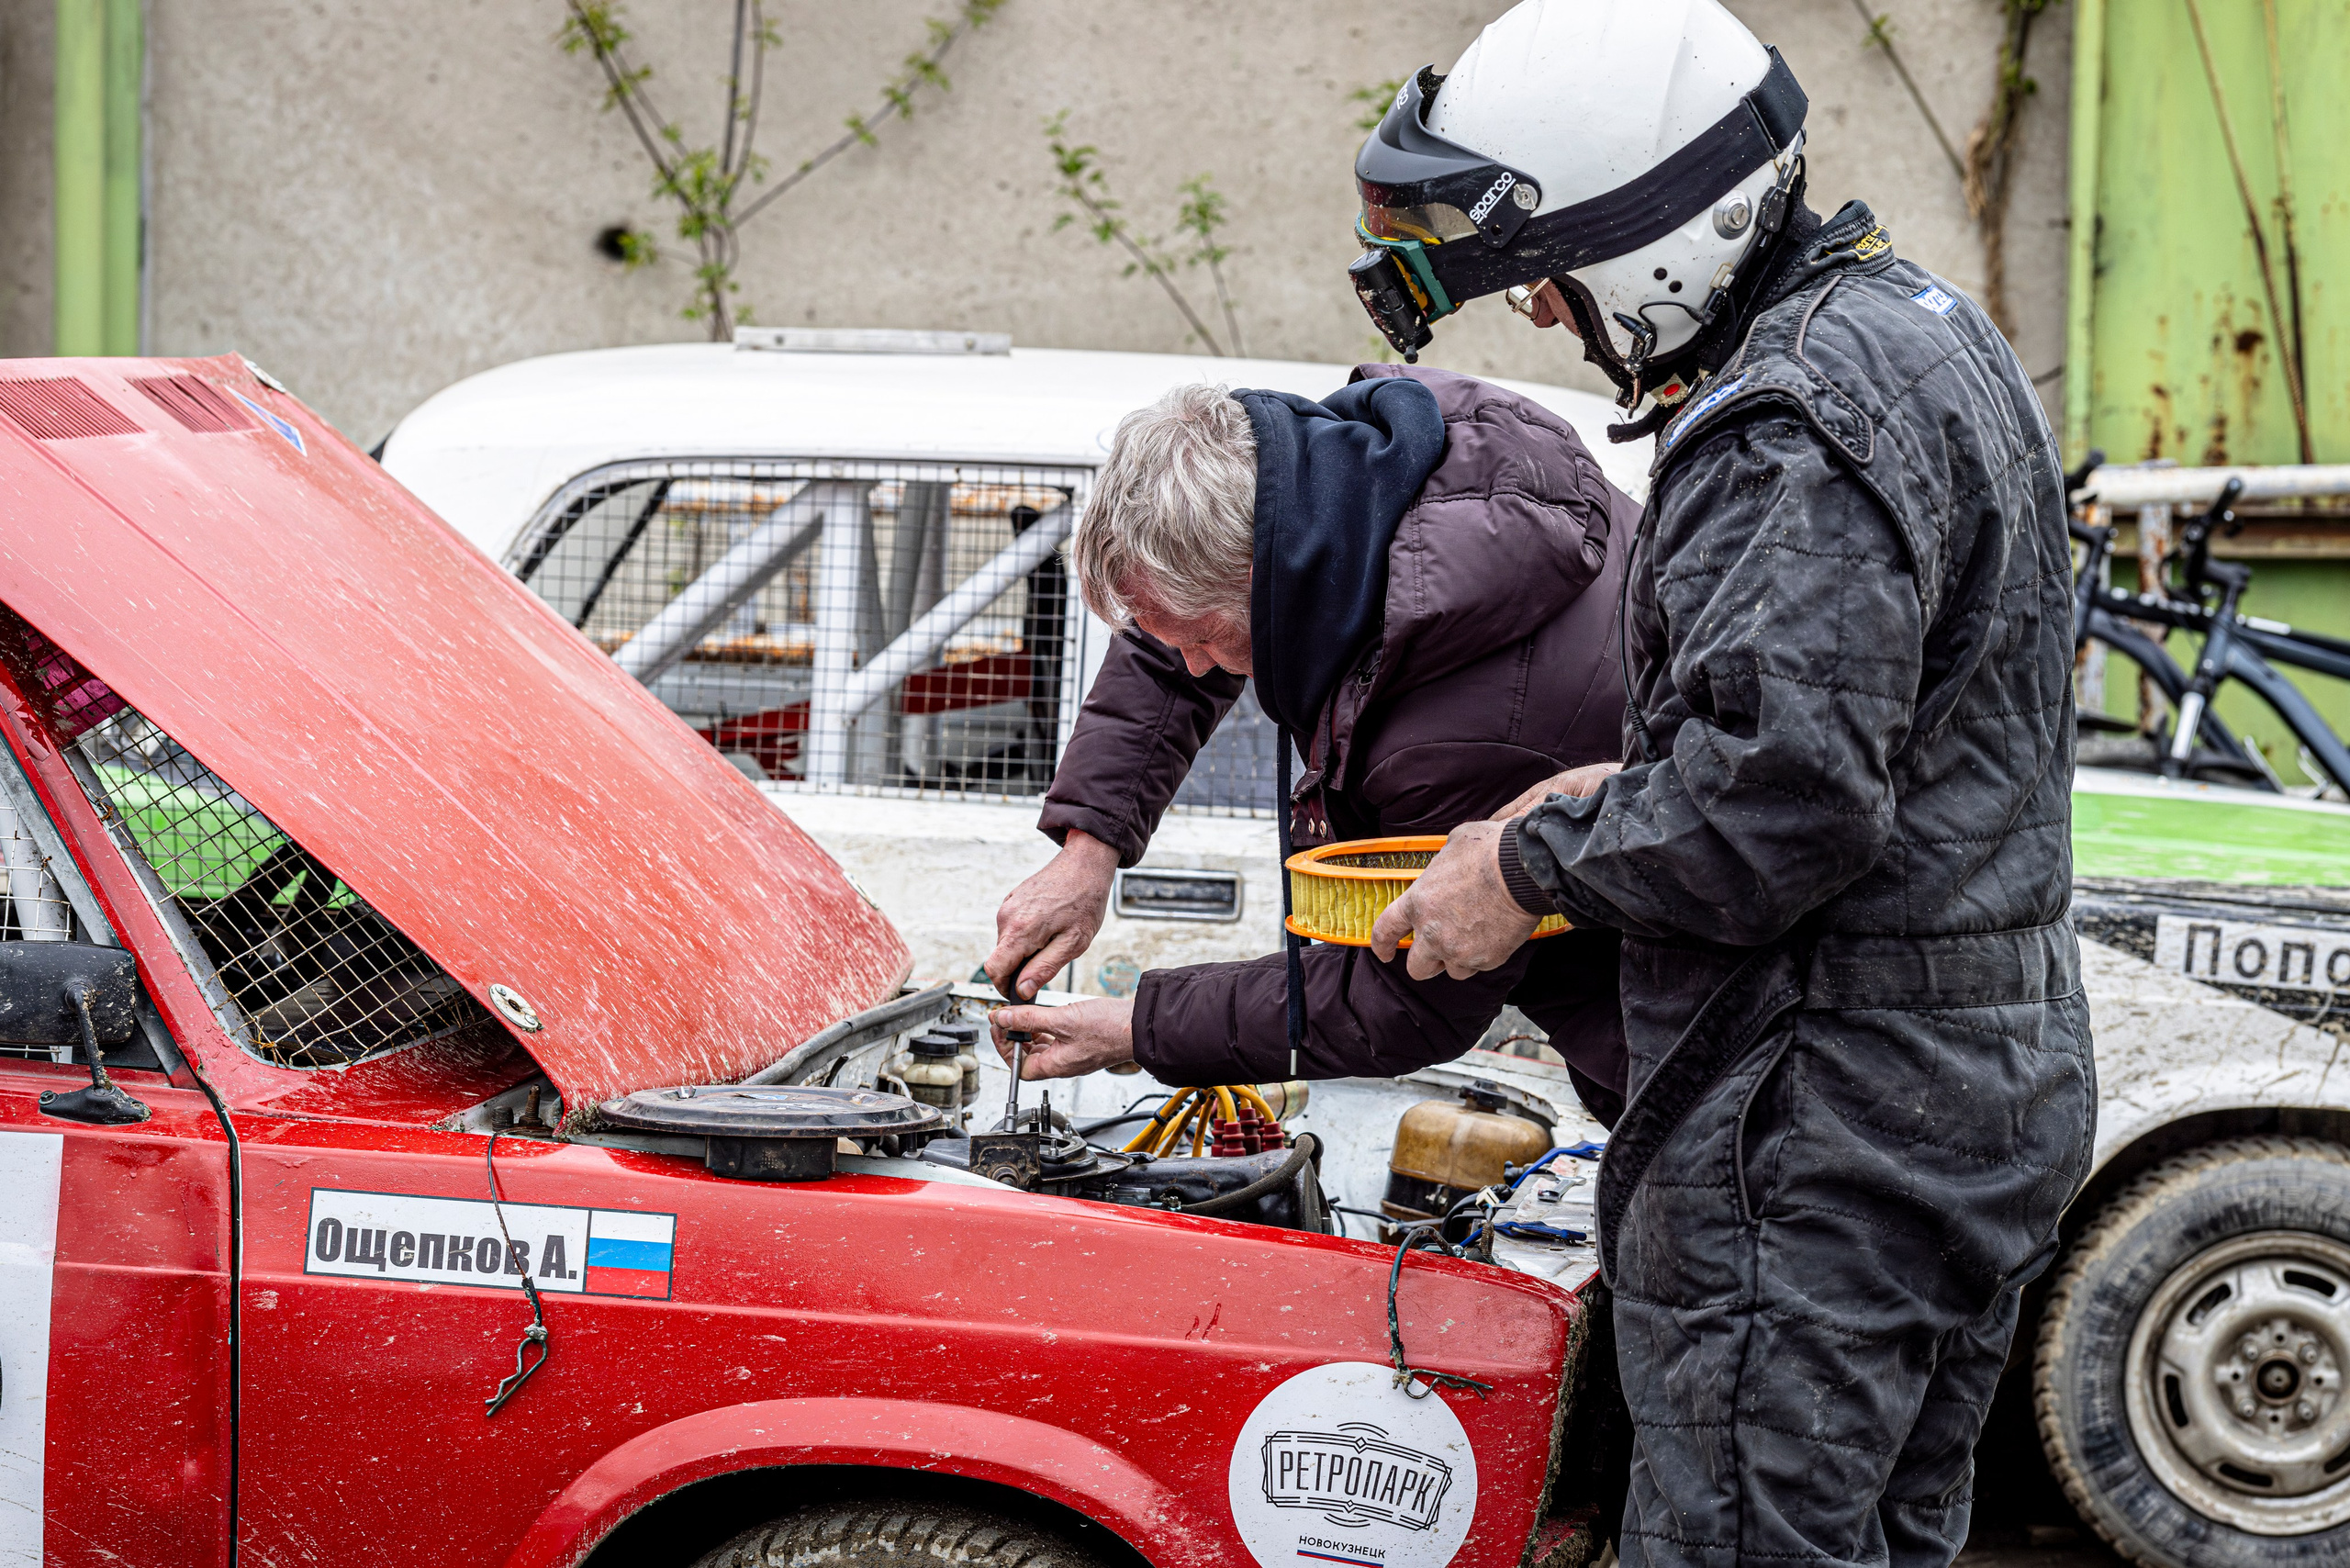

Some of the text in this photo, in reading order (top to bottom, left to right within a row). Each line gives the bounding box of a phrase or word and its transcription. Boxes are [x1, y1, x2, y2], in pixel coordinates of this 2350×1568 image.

[1469, 172, 1516, 223] sparco
[2184, 924, 2350, 986] Попо
[315, 1217, 577, 1280] Ощепков А.
[1280, 1450, 1436, 1514] РЕТРОПАРК
[1298, 1535, 1386, 1559] НОВОКУЗНЕЦК
